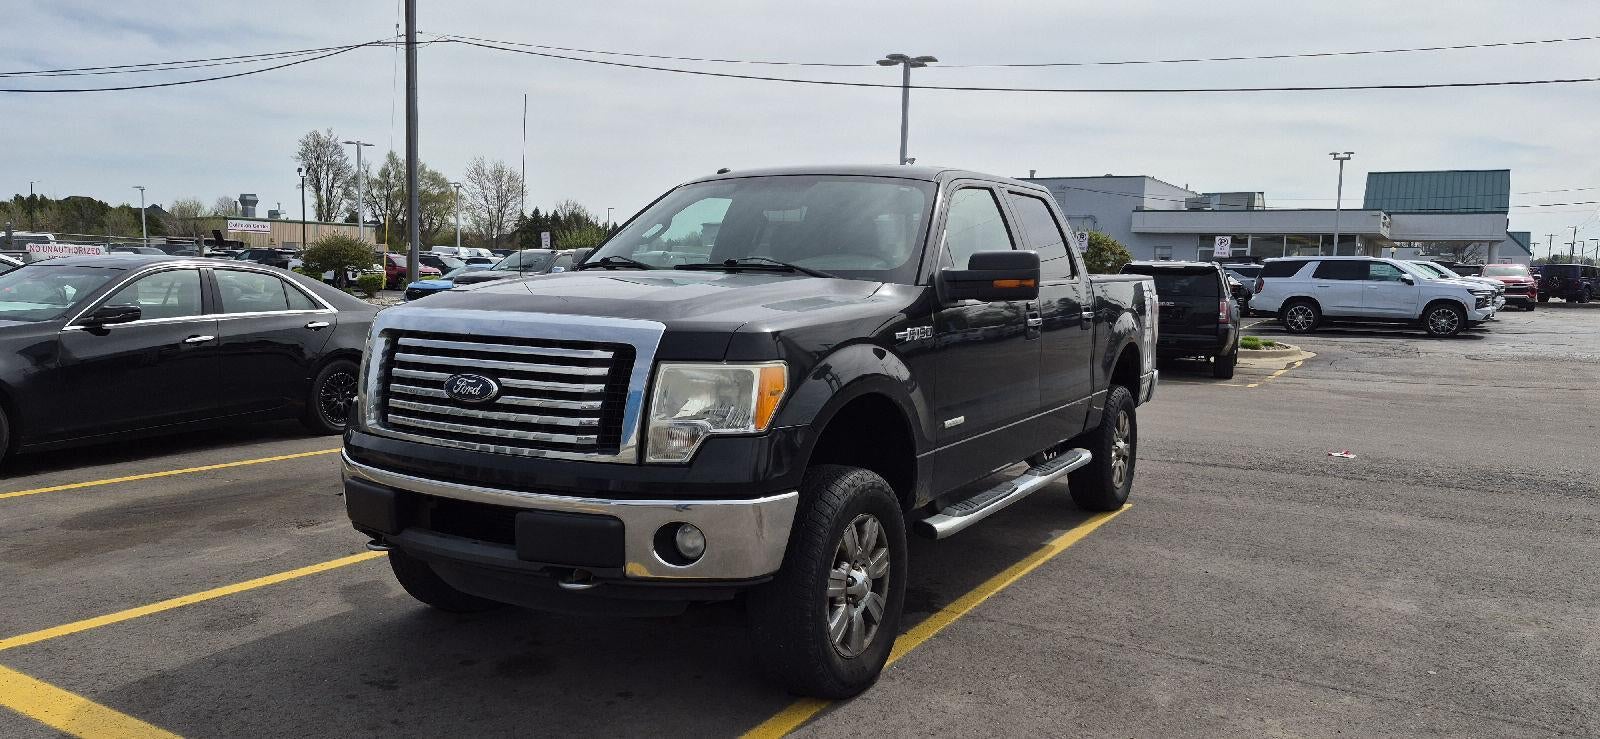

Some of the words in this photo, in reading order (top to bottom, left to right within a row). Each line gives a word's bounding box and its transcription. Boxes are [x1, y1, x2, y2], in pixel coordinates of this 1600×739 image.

[29, 244, 41, 253] NO
[42, 245, 101, 256] UNAUTHORIZED
[453, 378, 483, 395] Ford
